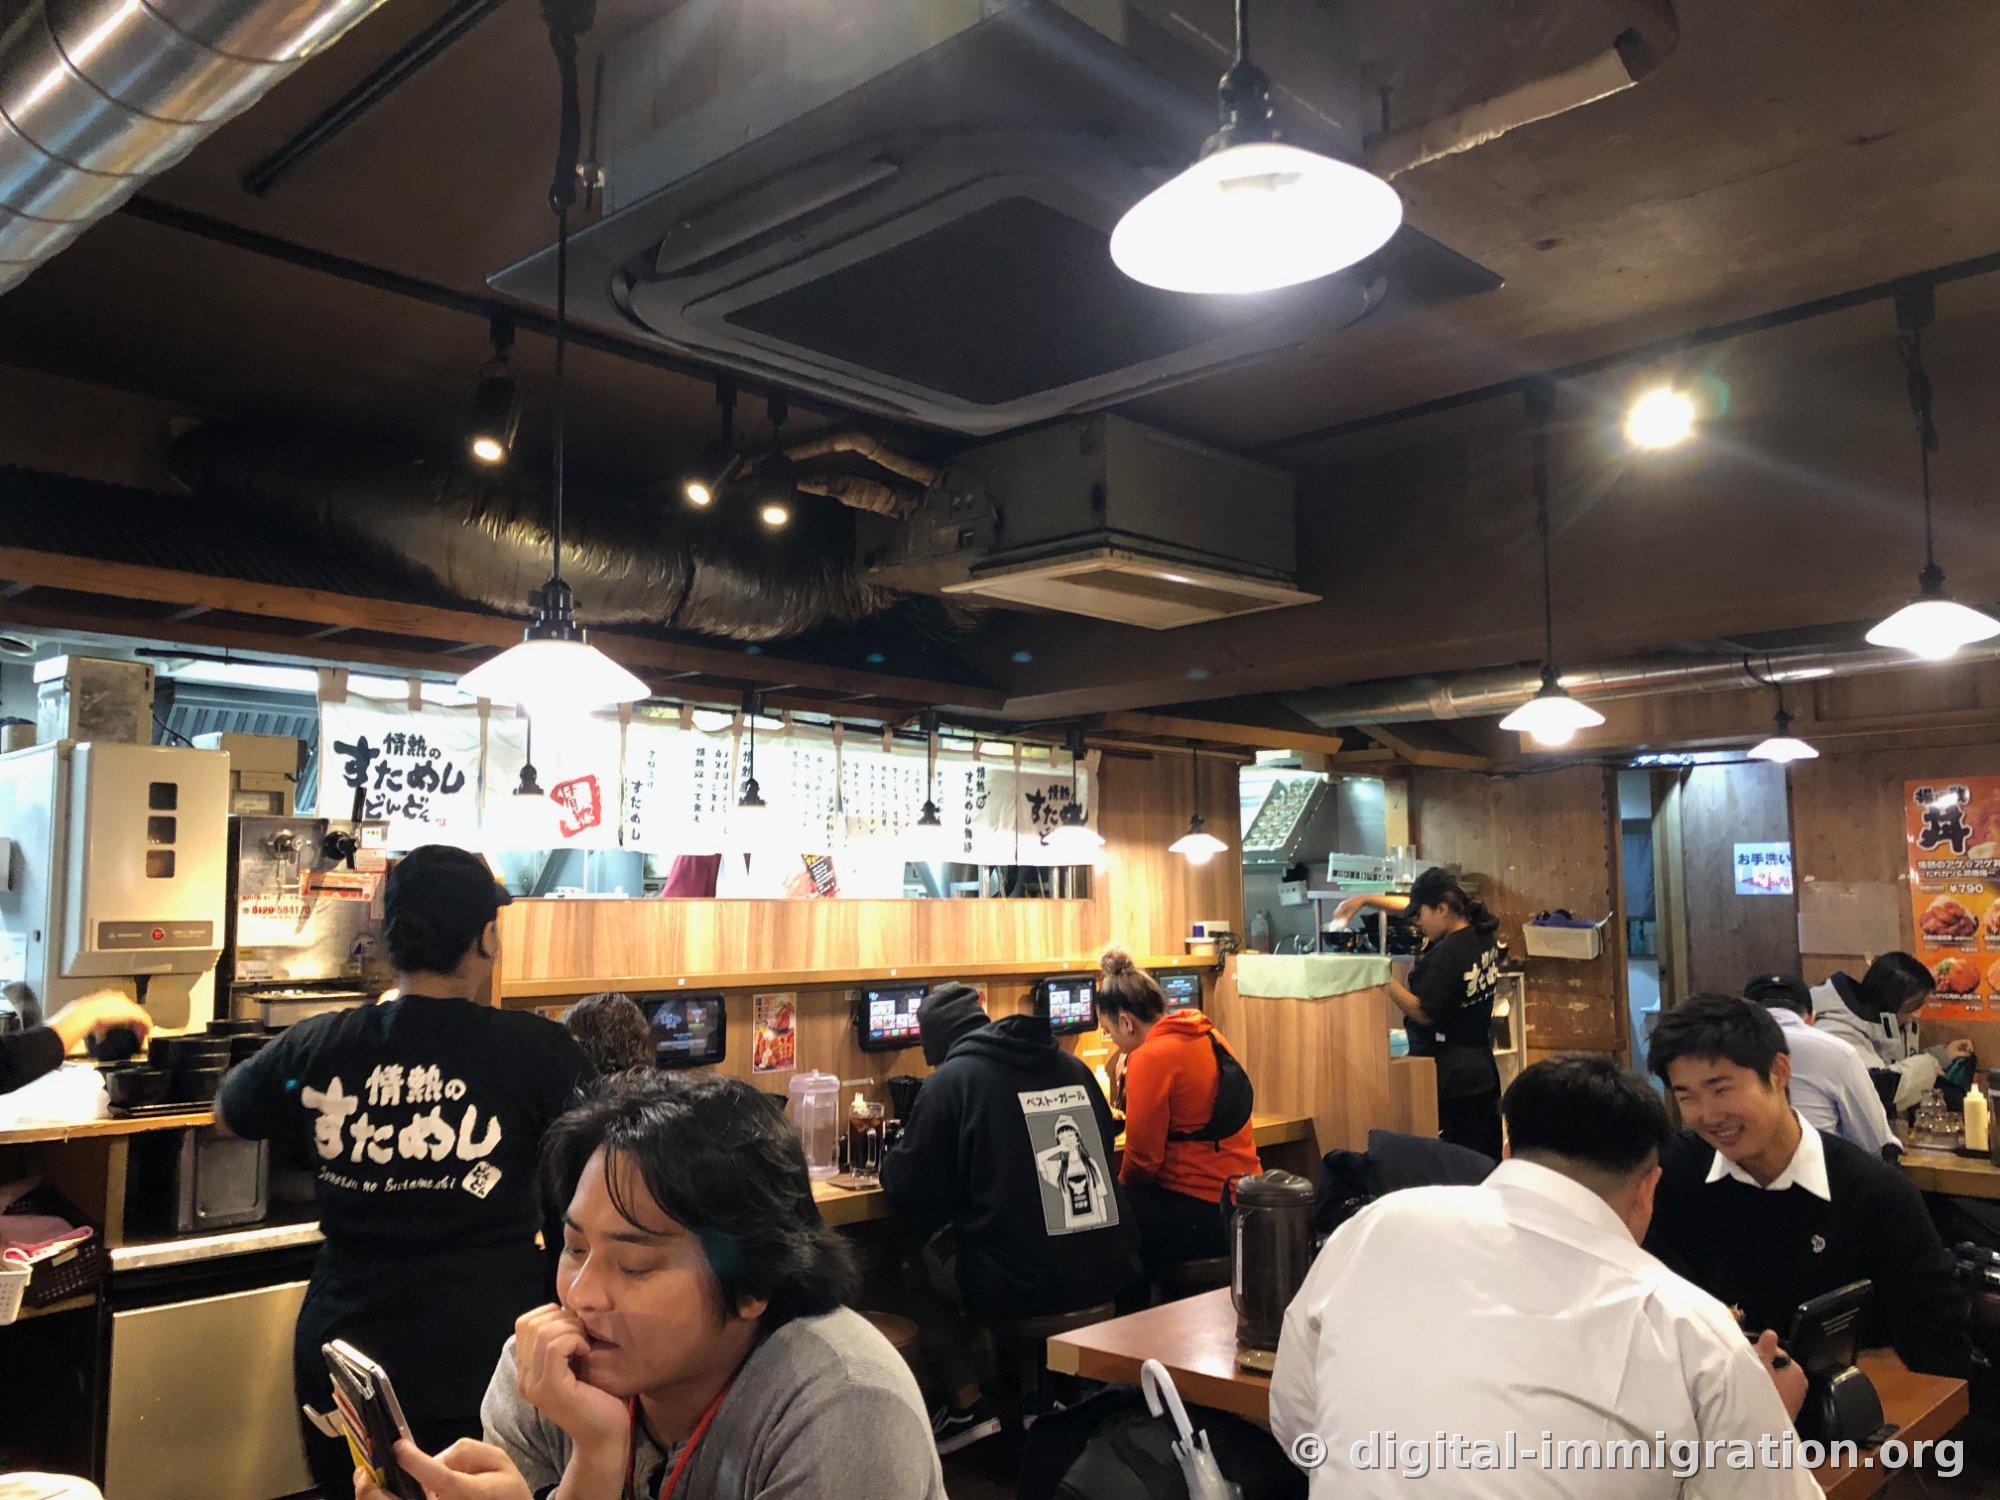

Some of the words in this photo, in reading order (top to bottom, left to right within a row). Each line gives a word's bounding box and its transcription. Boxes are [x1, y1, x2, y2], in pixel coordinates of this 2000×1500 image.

[383, 732, 441, 759] 情熱の
[333, 735, 465, 794] すためし
[365, 793, 430, 822] どんどん
[1738, 853, 1792, 866] お手洗い
[365, 1063, 467, 1106] 情熱の
[1026, 1090, 1085, 1107] ベスト・ガール
[301, 1076, 502, 1164] すためし
[363, 1181, 378, 1192] no
